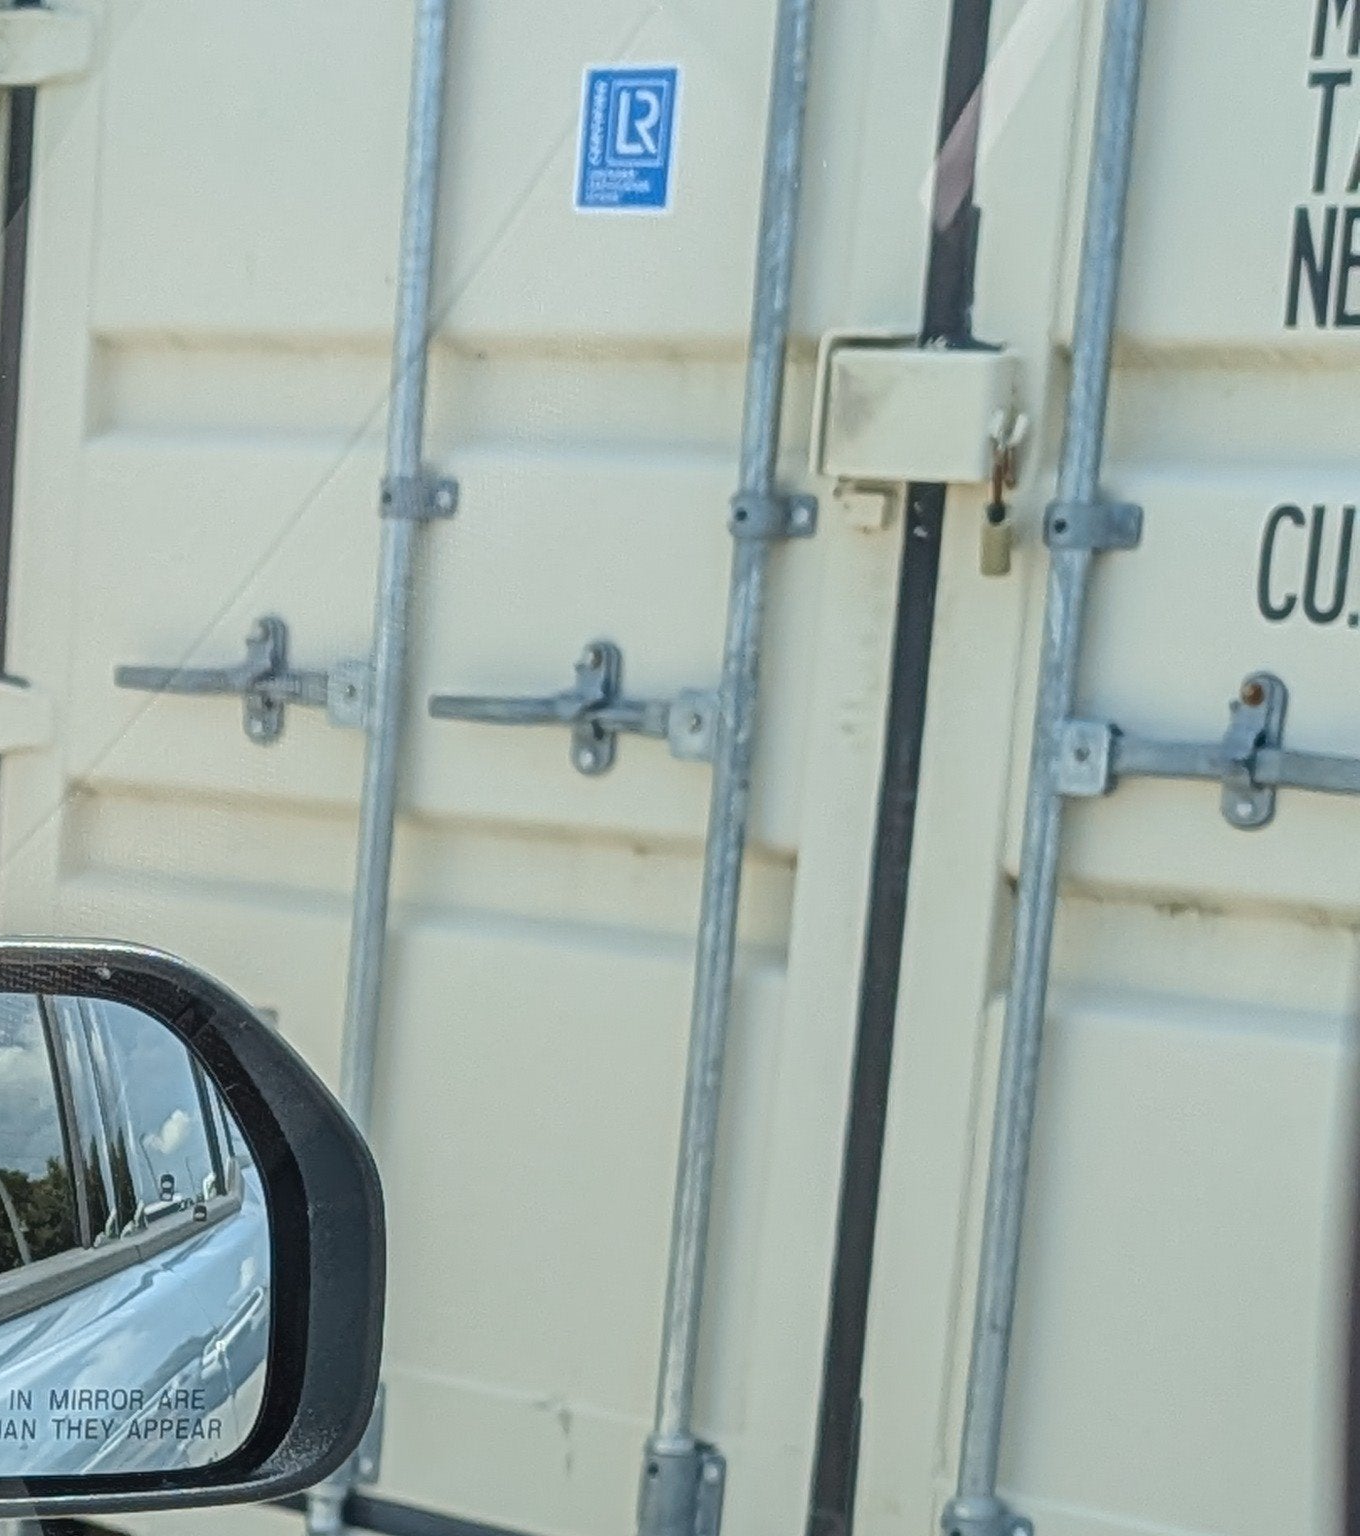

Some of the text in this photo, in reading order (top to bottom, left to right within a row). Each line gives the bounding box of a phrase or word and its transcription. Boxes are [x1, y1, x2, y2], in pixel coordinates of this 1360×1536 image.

[1308, 71, 1360, 193] T
[9, 1390, 33, 1411] IN
[50, 1390, 144, 1411] MIRROR
[160, 1390, 206, 1411] ARE
[53, 1419, 114, 1440] THEY
[125, 1419, 222, 1441] APPEAR
